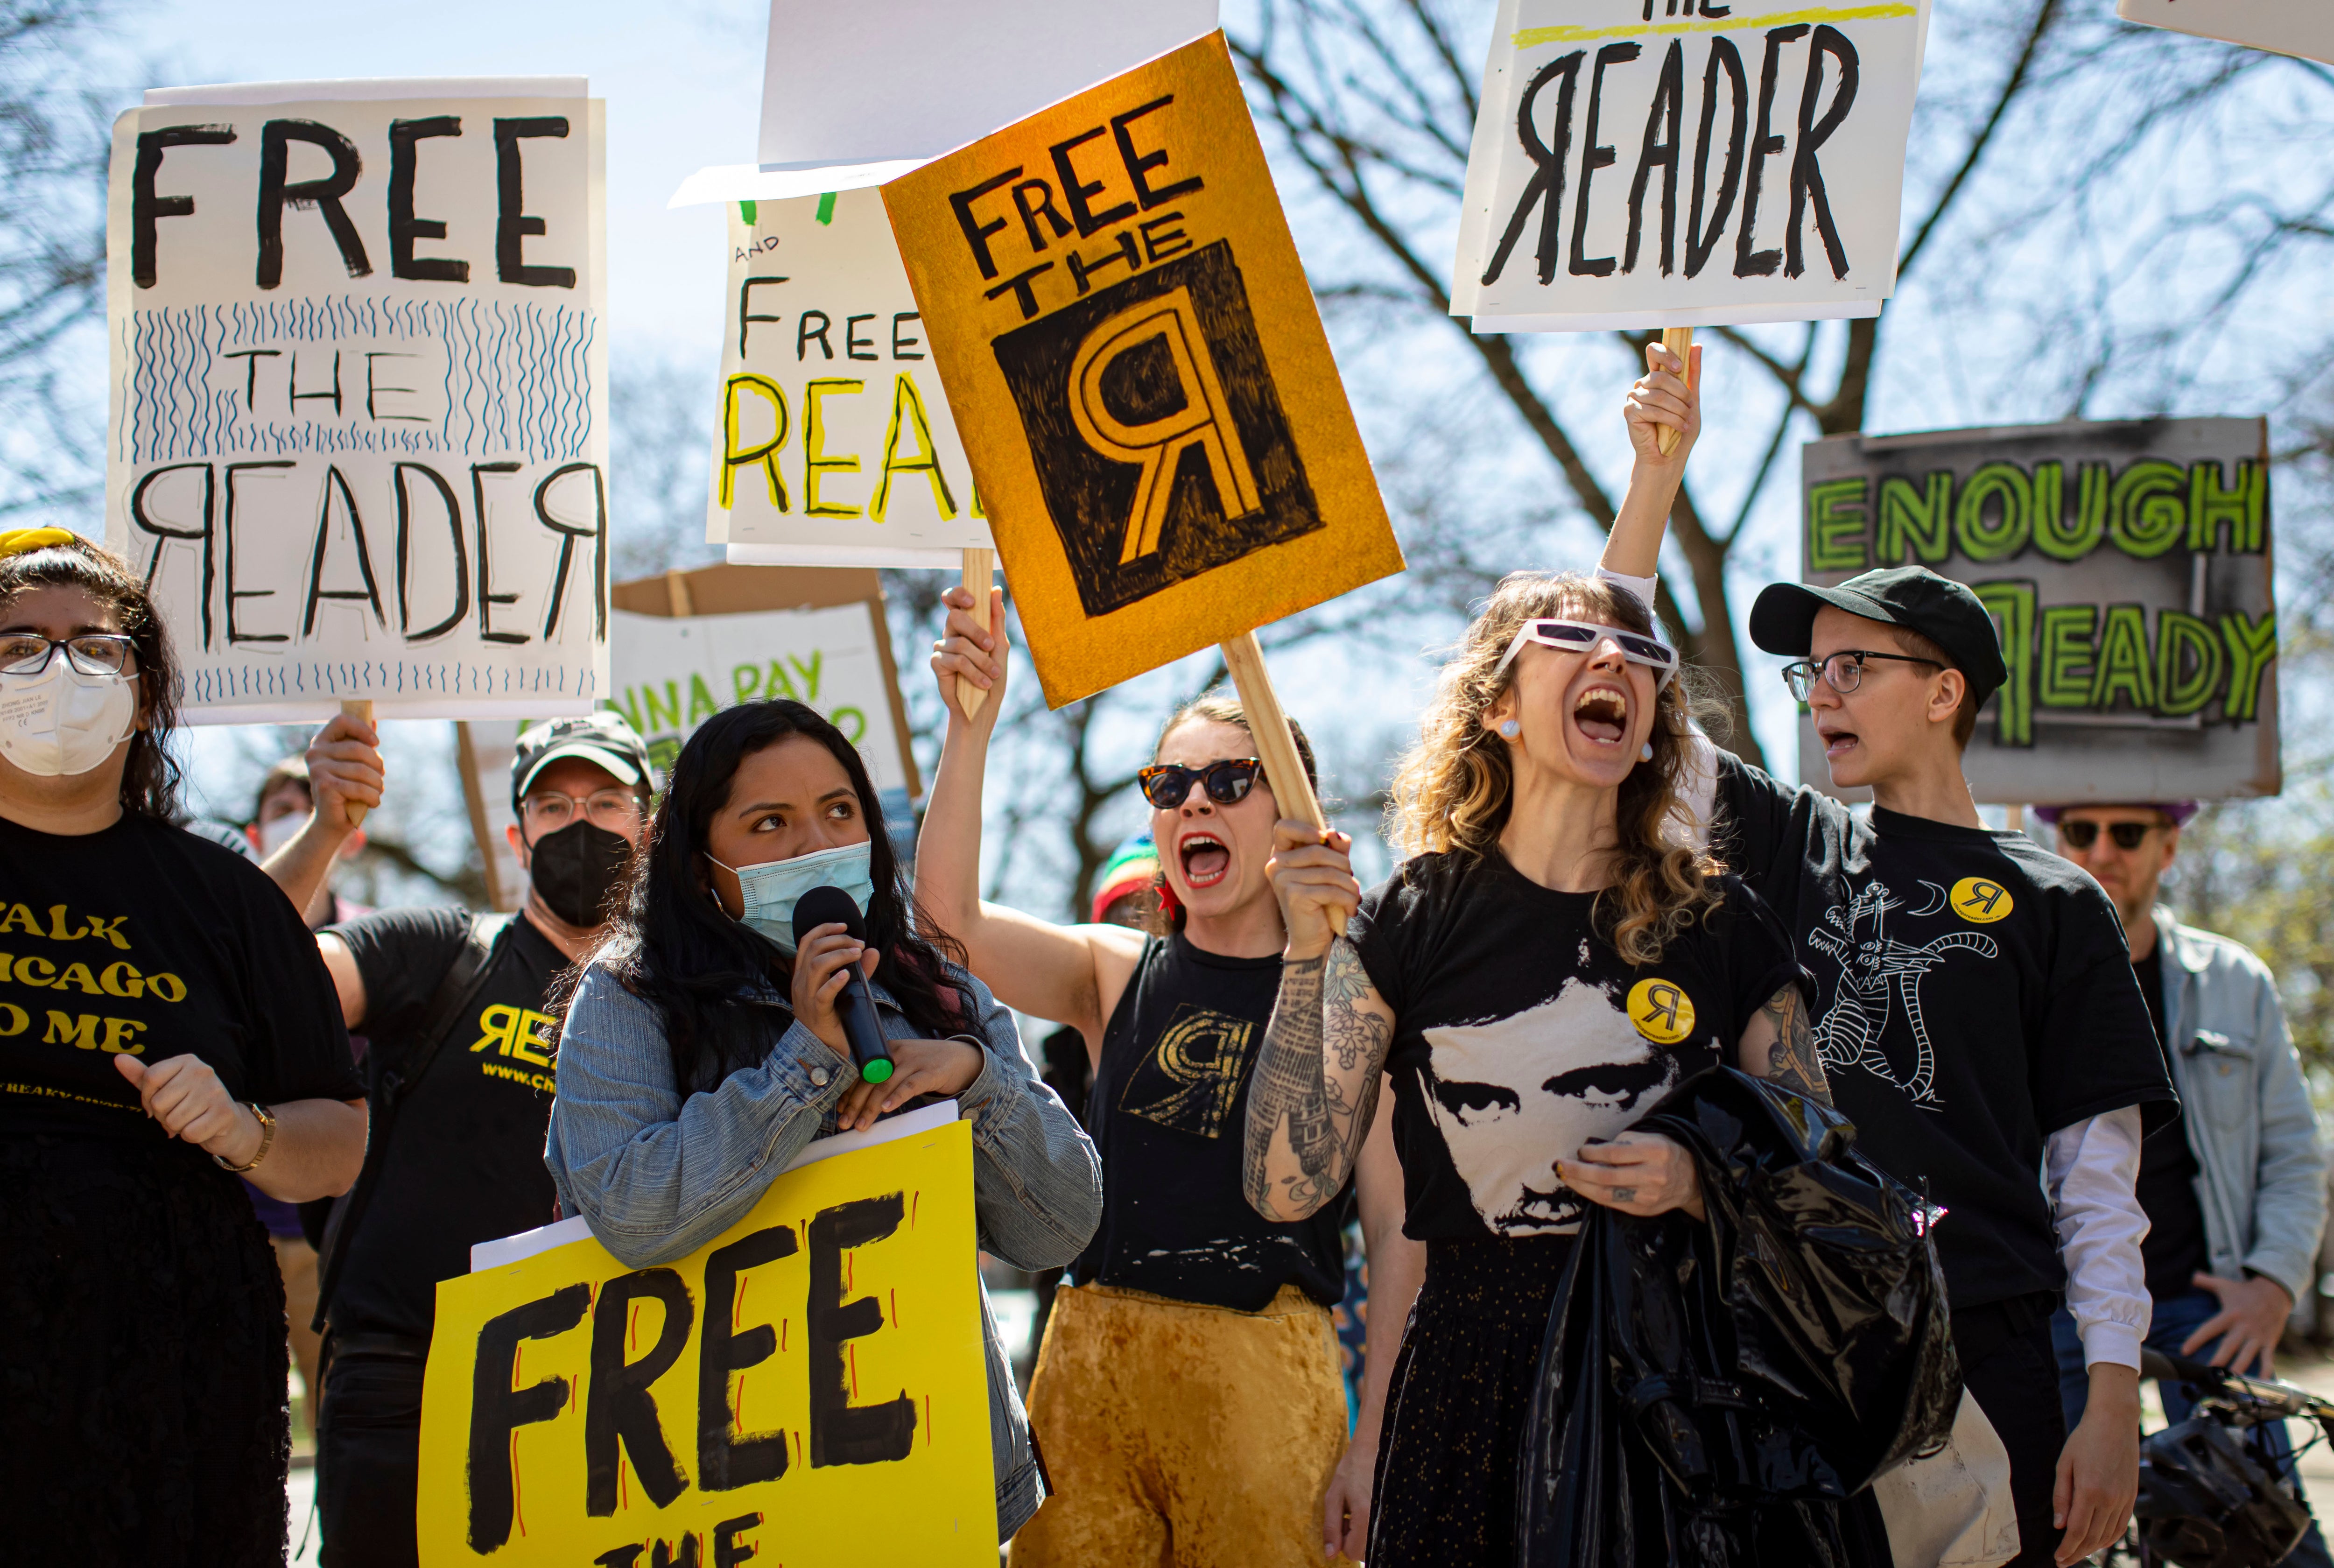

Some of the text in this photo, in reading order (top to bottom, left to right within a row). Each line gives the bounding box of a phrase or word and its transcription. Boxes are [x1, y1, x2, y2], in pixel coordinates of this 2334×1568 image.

[131, 115, 576, 289] FREE
[949, 95, 1205, 280] FREE
[734, 235, 780, 262] AND
[983, 211, 1194, 320] THE
[740, 276, 926, 362] FREE
[223, 348, 432, 422] THE
[719, 371, 988, 522] REA
[1807, 457, 2269, 572] ENOUGH
[731, 649, 822, 706] PAY
[0, 902, 132, 949] ALK
[1953, 902, 1994, 921] chicagoreader.com
[42, 1010, 148, 1055] ME
[469, 1003, 557, 1070] RE
[1633, 1018, 1680, 1041] chicagoreader.com
[0, 1083, 71, 1099] REAKY
[466, 1190, 917, 1555] FREE
